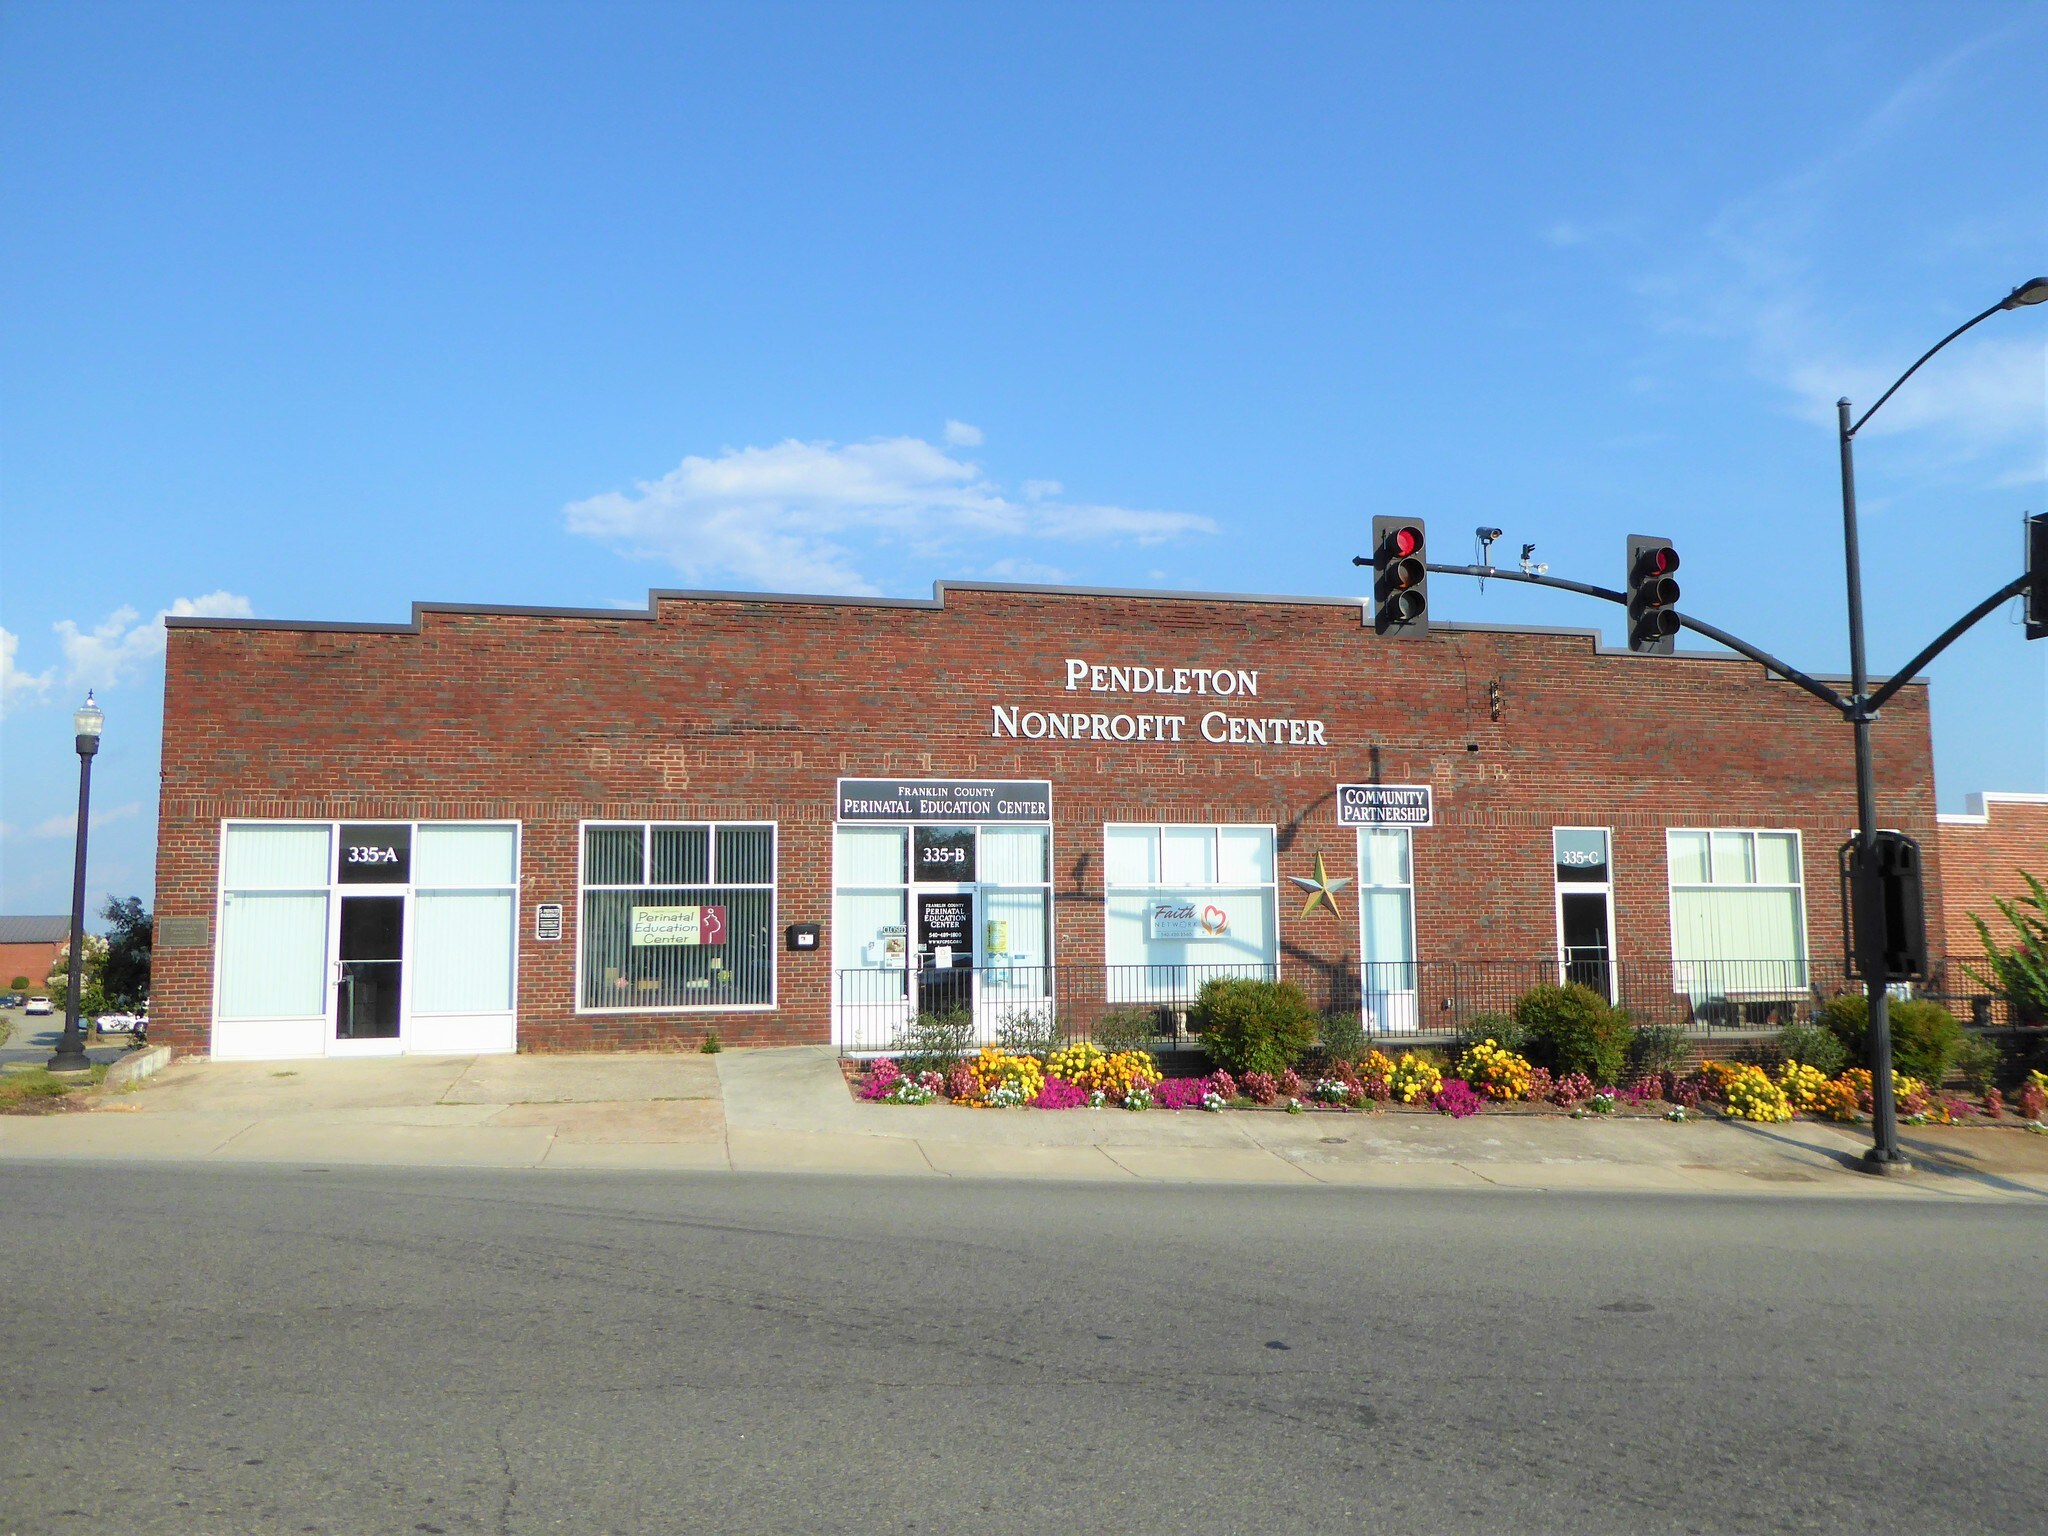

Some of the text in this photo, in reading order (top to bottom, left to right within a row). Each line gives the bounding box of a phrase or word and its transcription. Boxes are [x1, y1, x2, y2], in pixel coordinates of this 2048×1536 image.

[1065, 659, 1259, 696] PENDLETON
[991, 705, 1328, 746] NONPROFIT CENTER
[898, 786, 995, 797] FRANKLIN COUNTY
[1345, 789, 1424, 805] COMMUNITY
[843, 798, 1047, 815] PERINATAL EDUCATION CENTER
[1344, 805, 1428, 821] PARTNERSHIP
[348, 846, 399, 862] 335-A
[923, 847, 966, 862] 335-B
[1562, 851, 1599, 864] 335-C
[638, 911, 695, 922] Perinatal
[924, 914, 967, 922] EDUCATION
[1154, 904, 1198, 919] Faith
[635, 922, 698, 933] Education
[1154, 920, 1198, 928] NETWORK
[643, 933, 689, 943] Center
